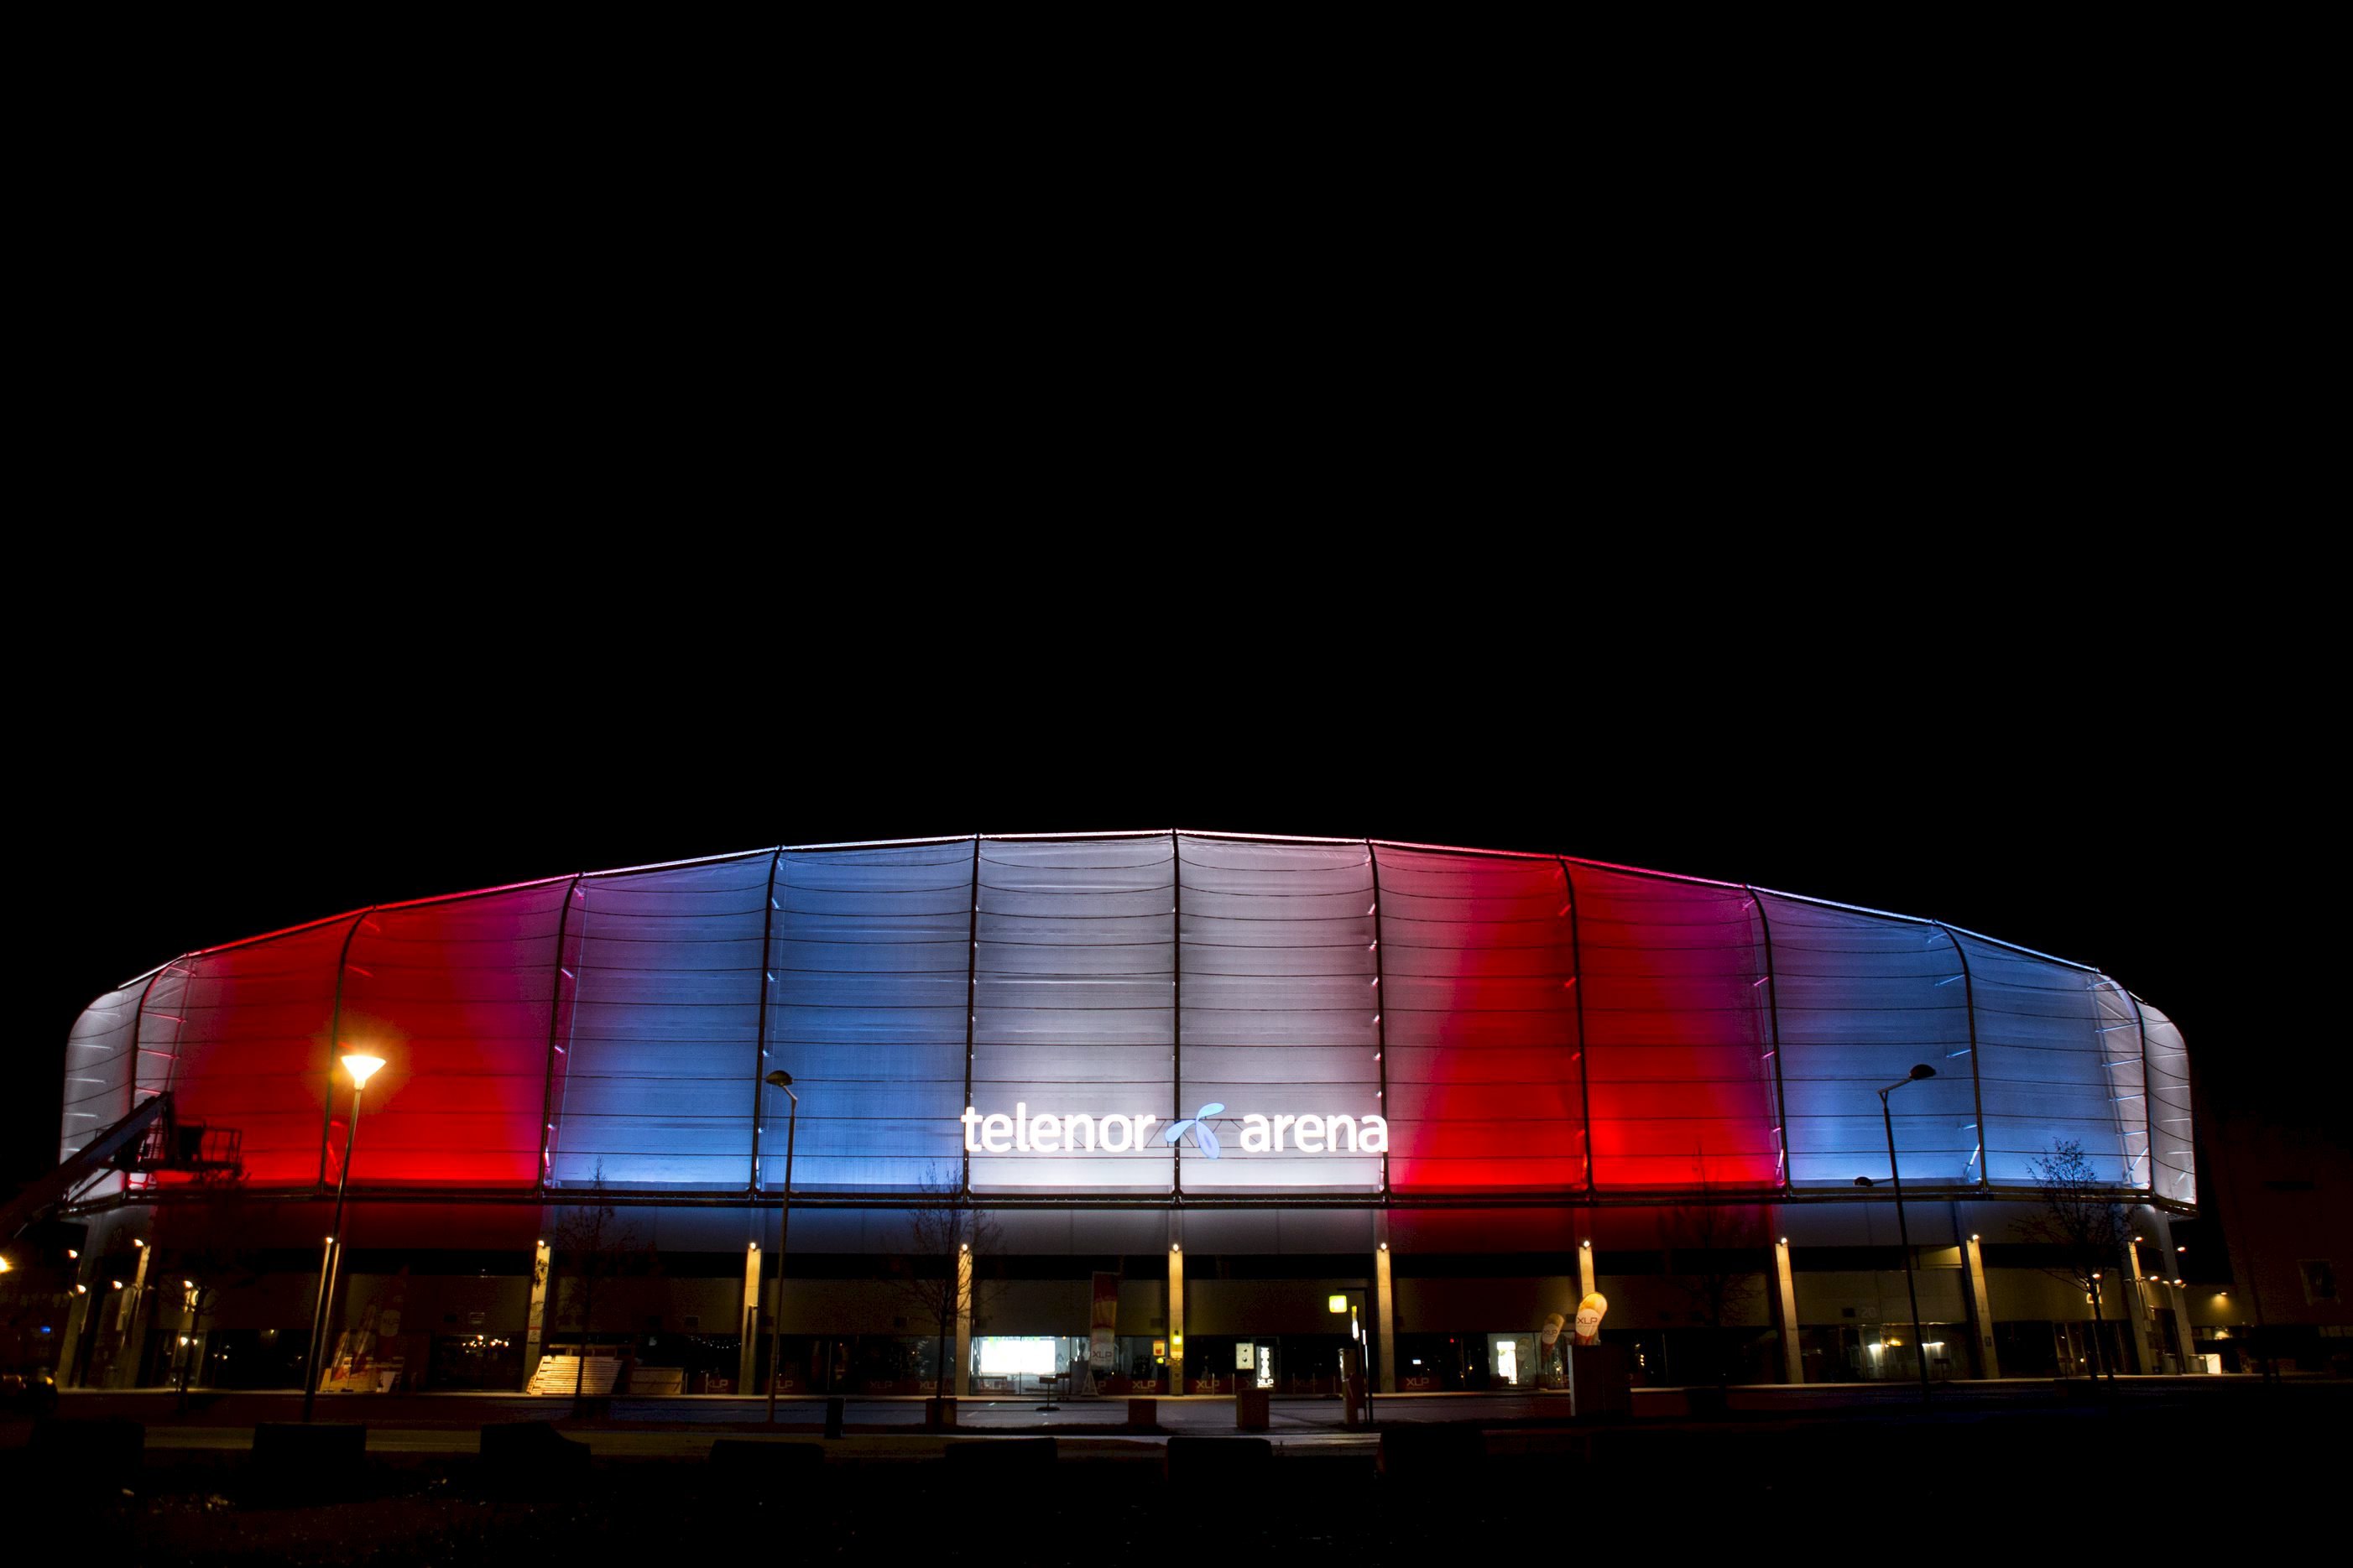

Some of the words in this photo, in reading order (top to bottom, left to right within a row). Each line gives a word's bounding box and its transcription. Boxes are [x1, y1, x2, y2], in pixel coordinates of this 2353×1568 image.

[960, 1102, 1156, 1153] telenor
[1239, 1113, 1390, 1153] arena
[1576, 1316, 1598, 1325] XLP
[1092, 1350, 1113, 1359] XLP
[869, 1380, 894, 1390] XLP
[919, 1381, 938, 1390] XL
[1132, 1380, 1156, 1390] XLP
[1195, 1379, 1221, 1389] XLP
[1257, 1378, 1274, 1387] XLP
[1406, 1377, 1430, 1387] XLP
